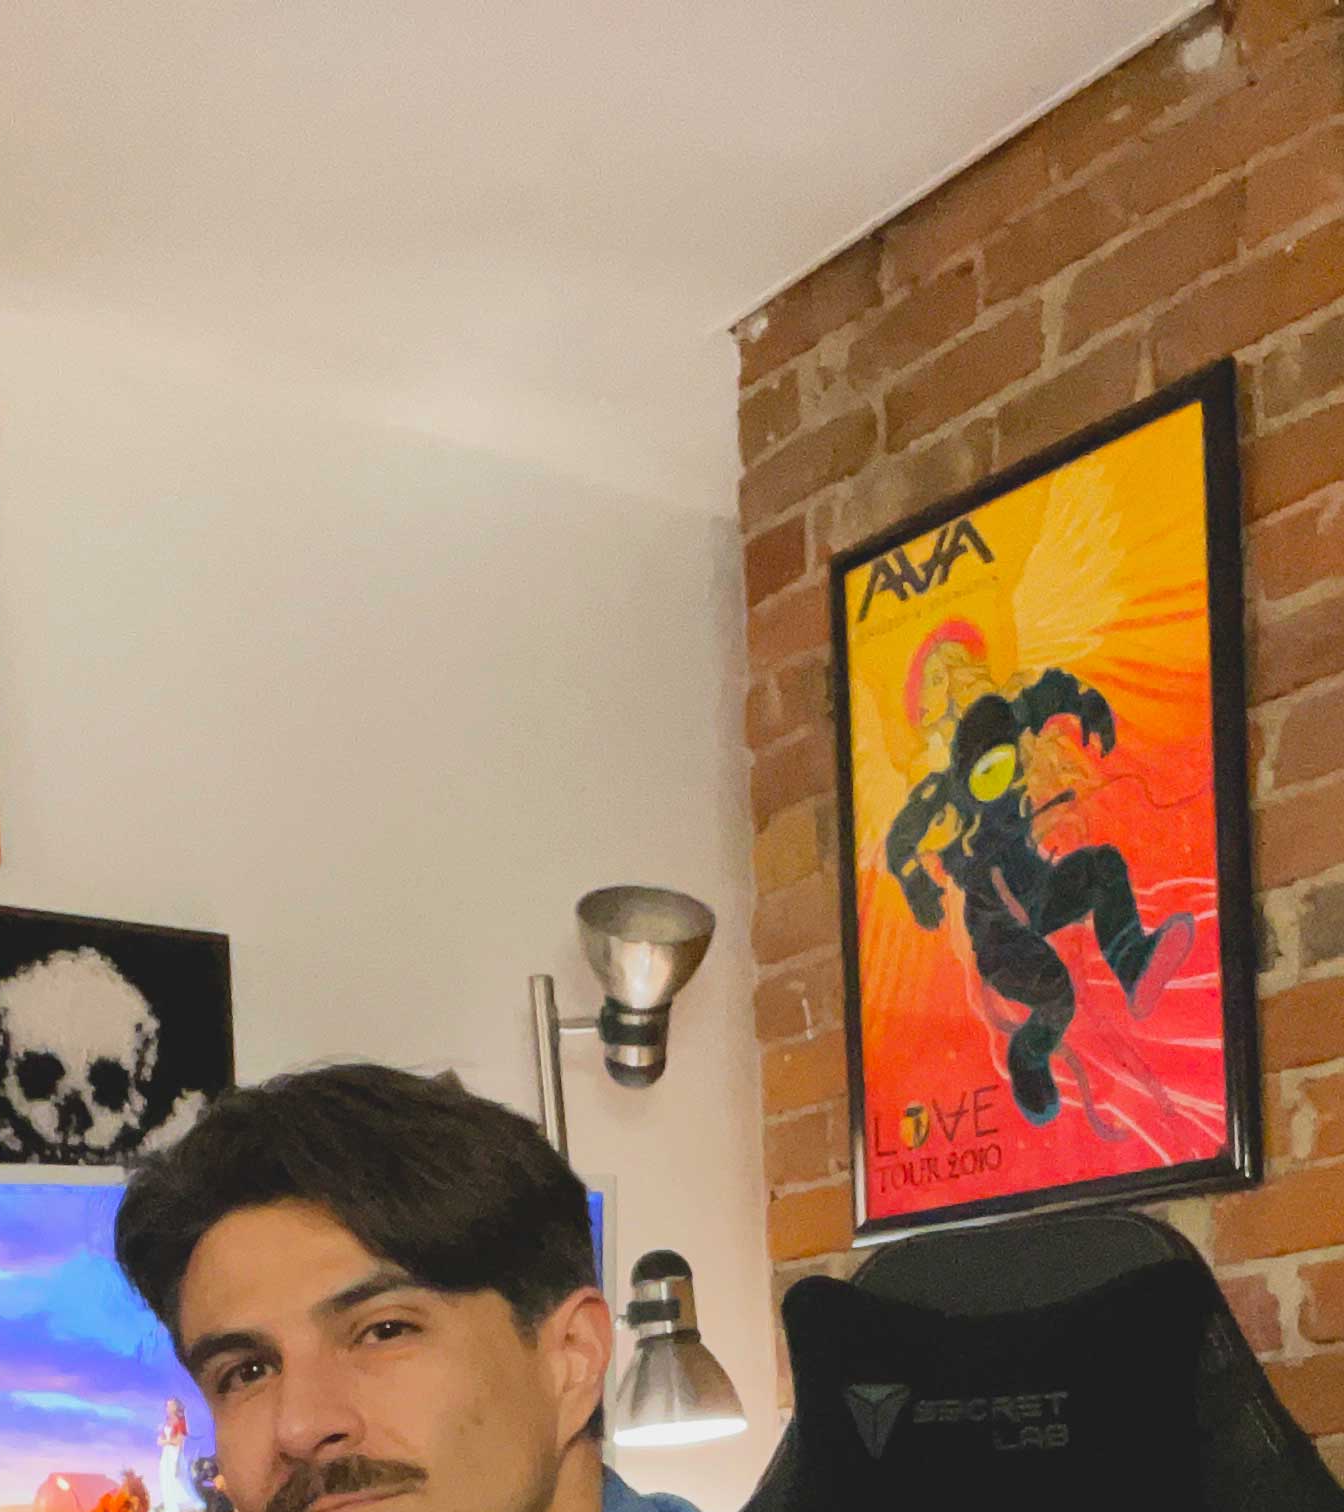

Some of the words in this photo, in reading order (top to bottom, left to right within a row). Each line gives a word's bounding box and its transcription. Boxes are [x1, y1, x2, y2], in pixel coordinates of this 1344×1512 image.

[857, 518, 996, 623] AVA
[874, 1156, 941, 1195] TOUR
[947, 1142, 1003, 1180] 2010
